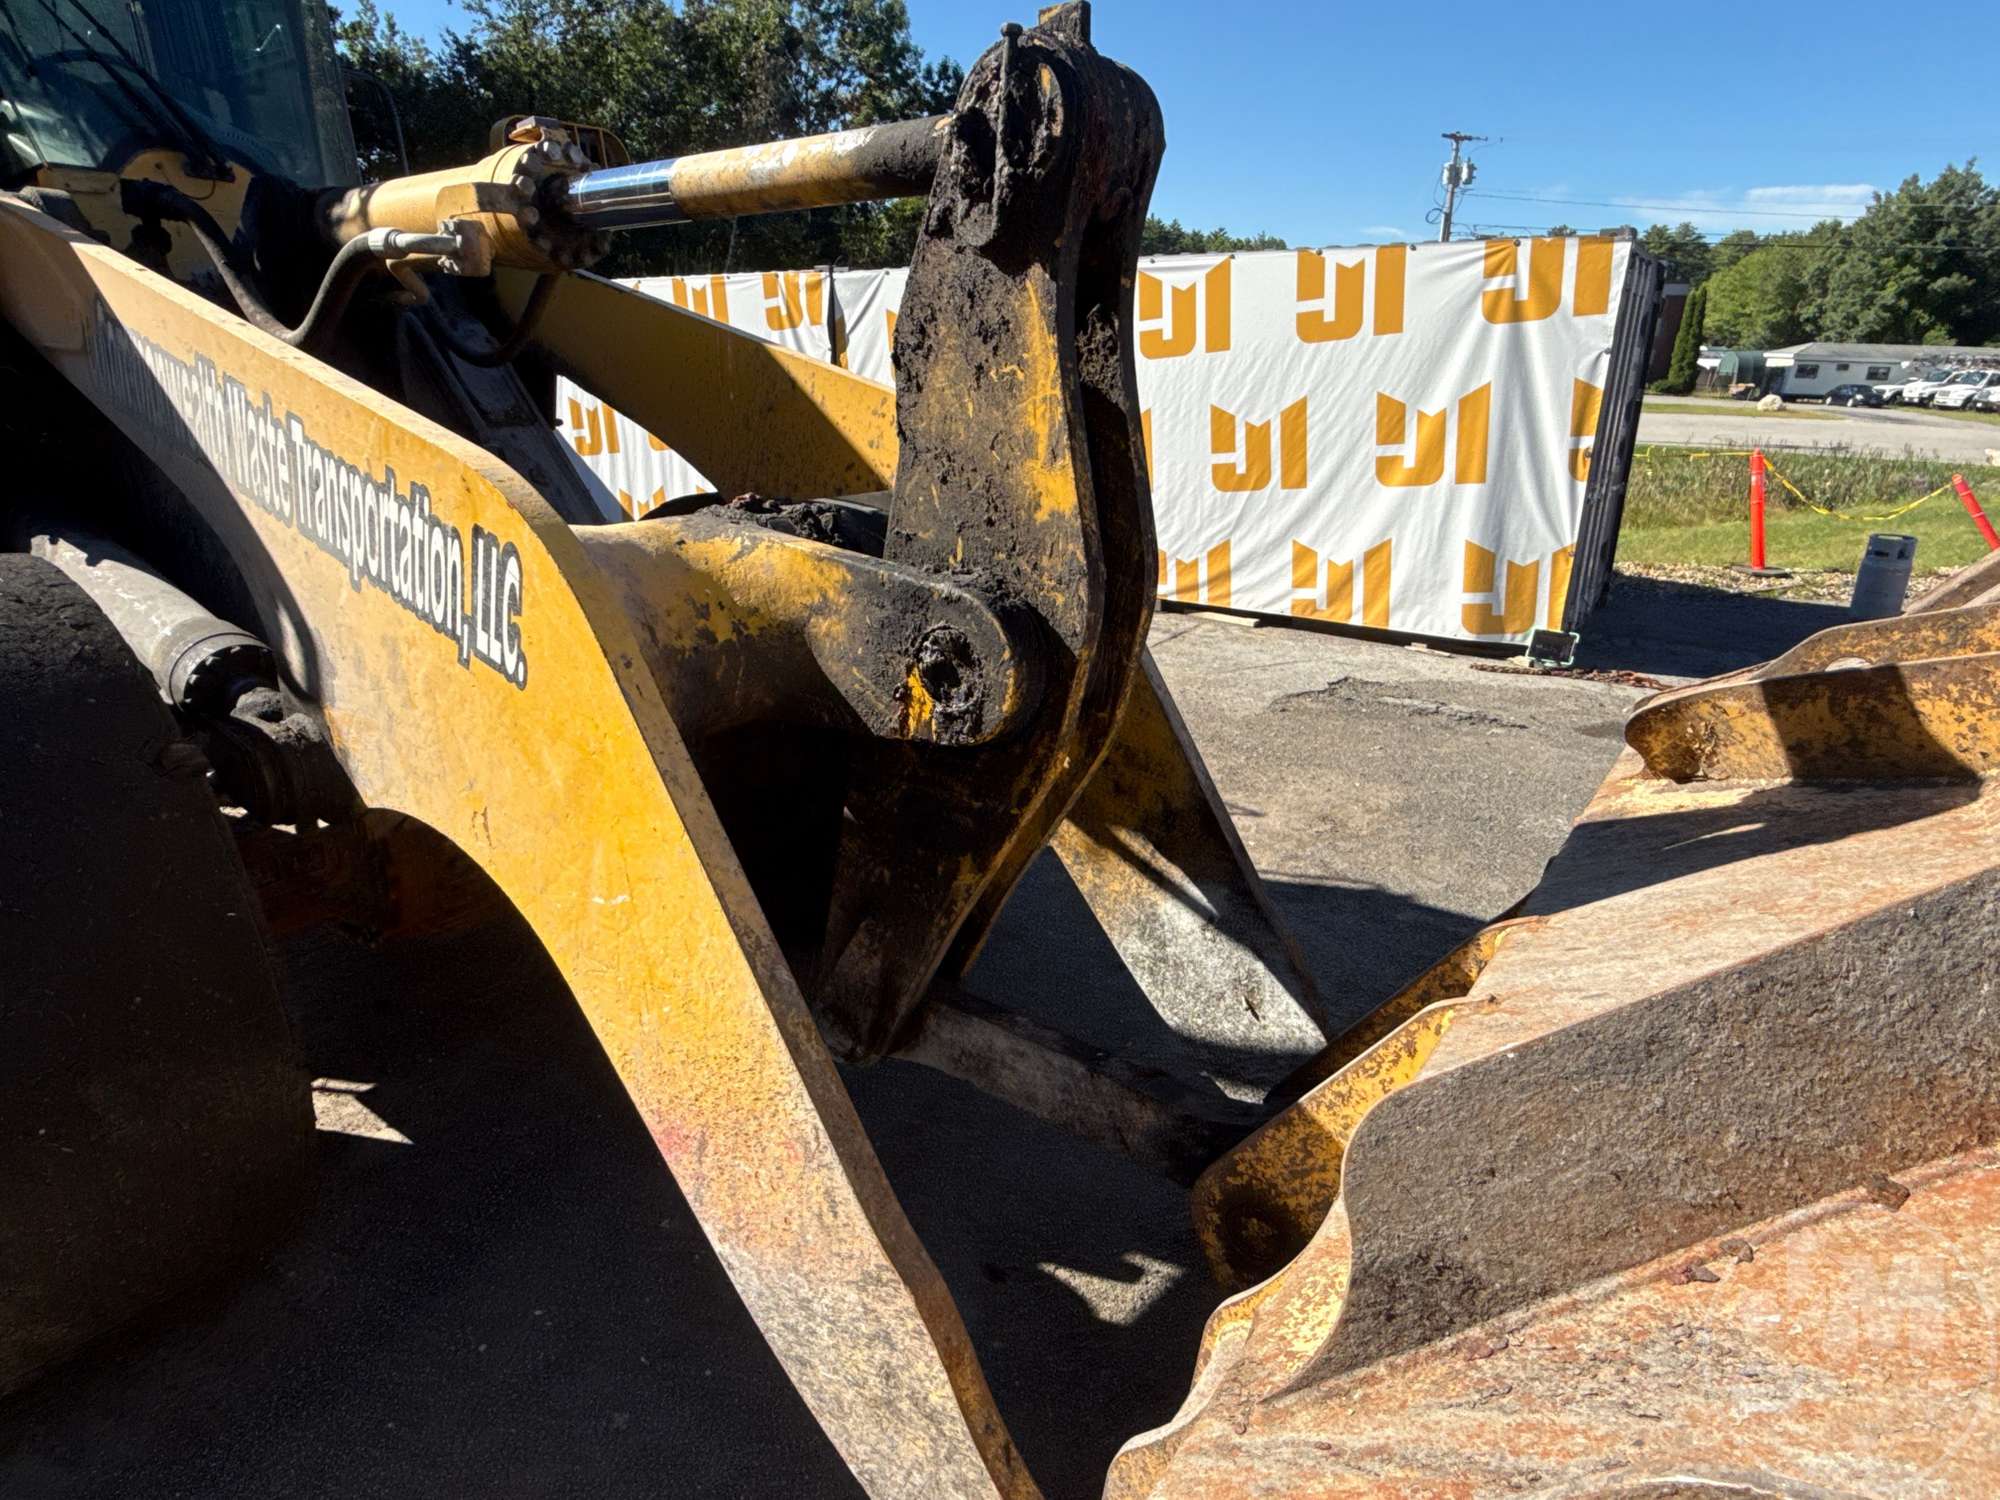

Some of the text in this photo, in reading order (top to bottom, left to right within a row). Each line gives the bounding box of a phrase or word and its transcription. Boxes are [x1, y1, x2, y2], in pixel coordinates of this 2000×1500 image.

[224, 378, 292, 521] Waste
[289, 416, 470, 663] Transportation,
[474, 532, 526, 685] LLC.
